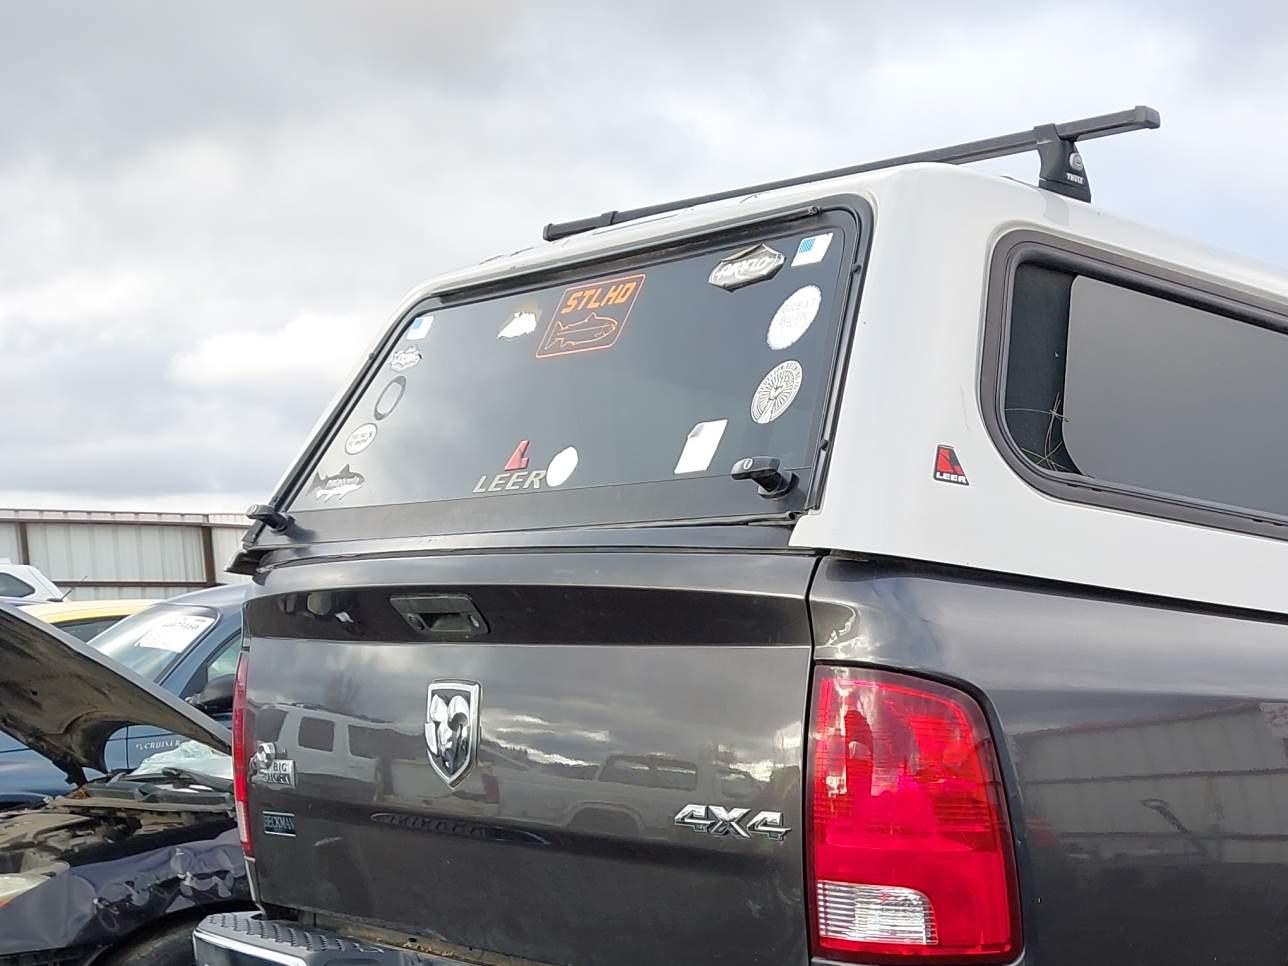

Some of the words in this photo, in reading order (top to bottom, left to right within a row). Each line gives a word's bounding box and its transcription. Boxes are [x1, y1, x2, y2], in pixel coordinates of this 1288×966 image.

[561, 282, 637, 314] STLHD
[472, 470, 547, 493] LEER
[936, 471, 967, 484] LEER
[273, 762, 288, 773] BIG
